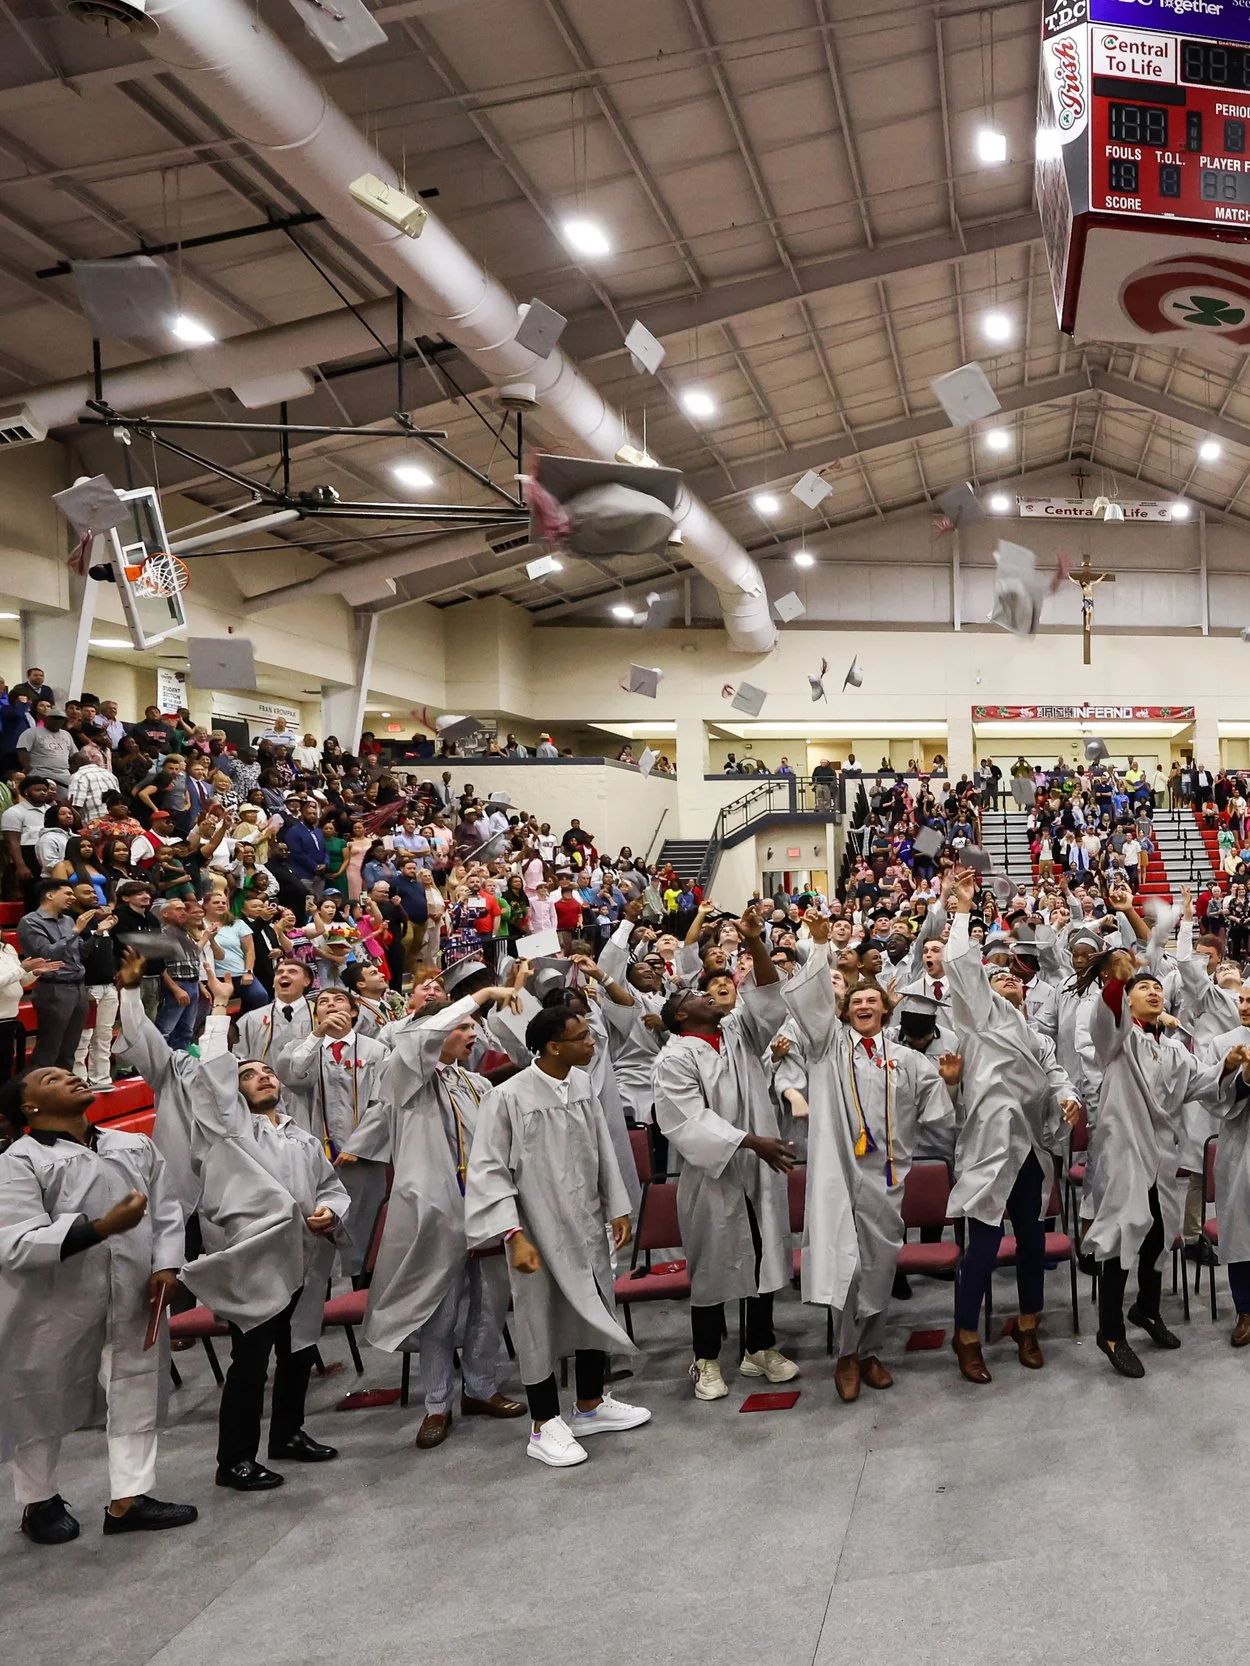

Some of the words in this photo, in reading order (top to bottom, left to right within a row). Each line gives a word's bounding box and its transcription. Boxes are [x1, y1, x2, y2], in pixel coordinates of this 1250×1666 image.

[1045, 0, 1086, 31] TDC
[1101, 34, 1168, 58] Central
[1106, 55, 1126, 72] To
[1131, 59, 1162, 77] Life
[1055, 41, 1083, 116] Irish
[1105, 145, 1142, 161] FOULS
[1155, 151, 1186, 166] T.O.L.
[1200, 156, 1241, 172] PLAYER
[1105, 195, 1142, 211] SCORE
[1044, 505, 1093, 517] Centra
[1123, 508, 1148, 518] Life
